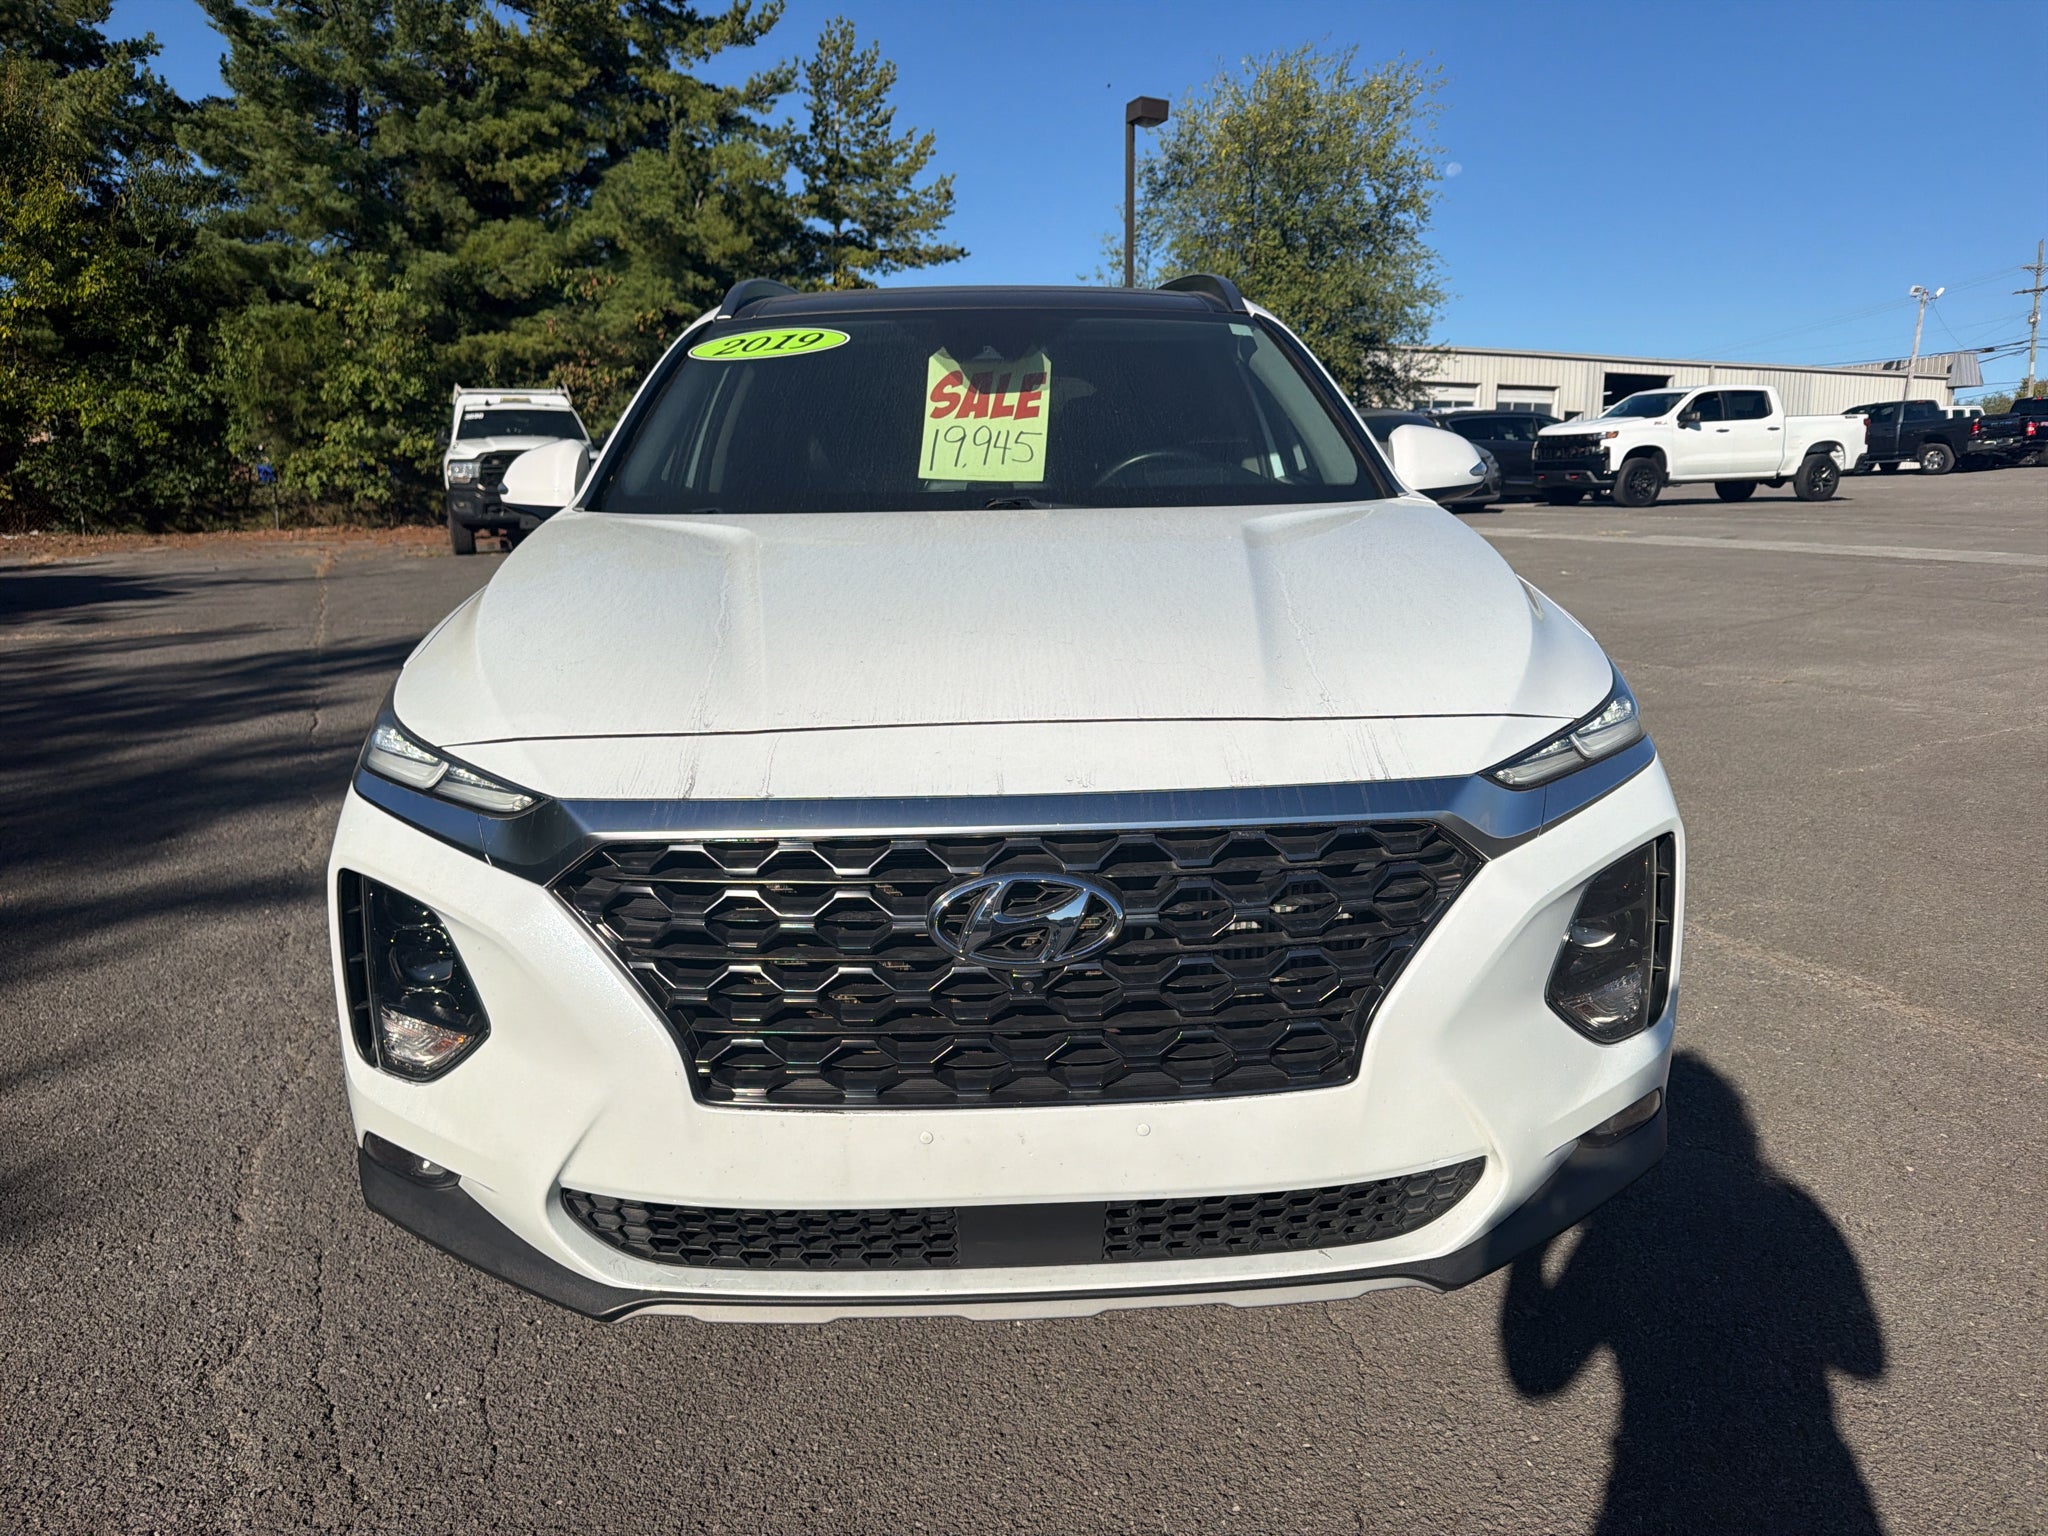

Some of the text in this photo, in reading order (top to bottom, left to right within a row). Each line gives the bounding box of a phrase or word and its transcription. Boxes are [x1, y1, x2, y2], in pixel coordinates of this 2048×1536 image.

[712, 332, 825, 356] 2019
[929, 370, 1047, 420] SALE
[929, 425, 1043, 471] 19,945
